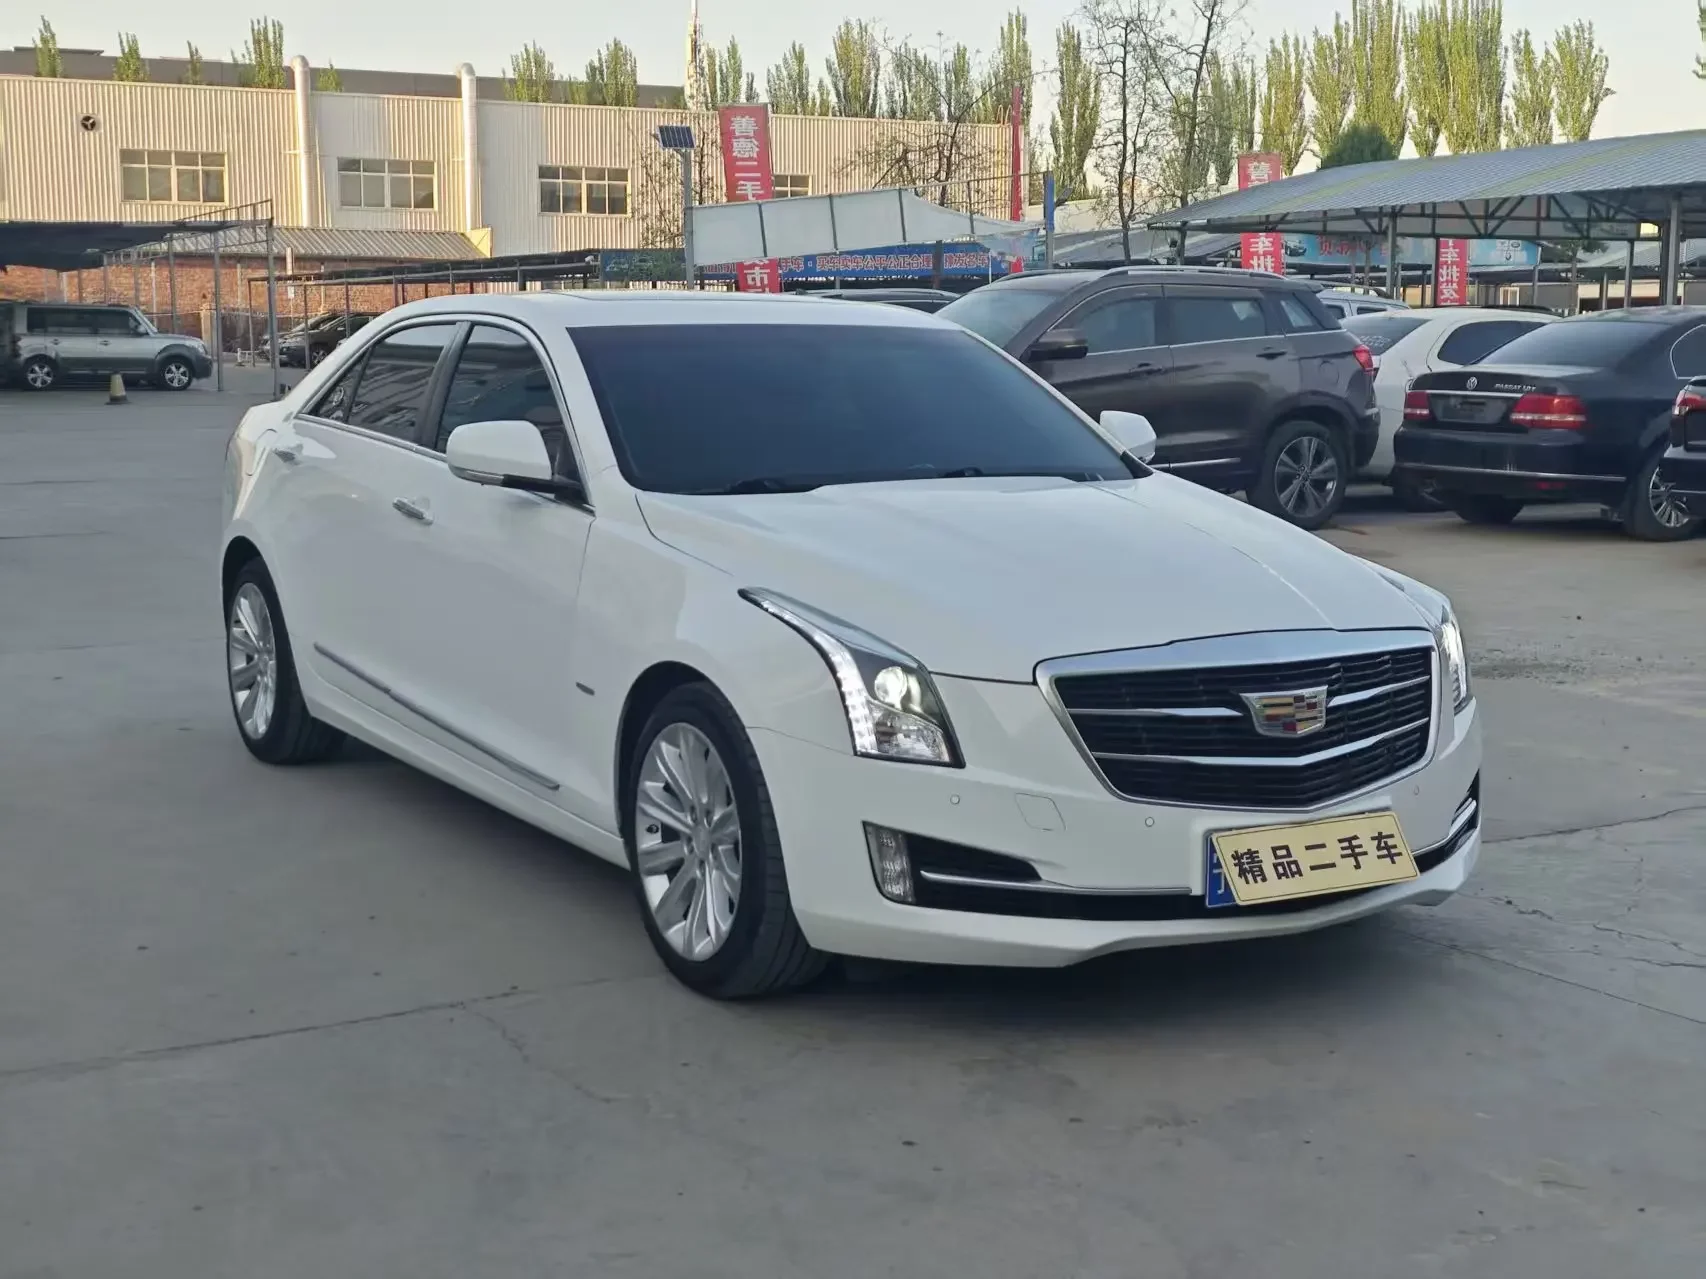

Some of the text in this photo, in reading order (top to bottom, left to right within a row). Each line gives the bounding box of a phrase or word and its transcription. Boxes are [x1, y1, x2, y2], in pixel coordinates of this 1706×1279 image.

[1231, 831, 1403, 885] 精品二手车
